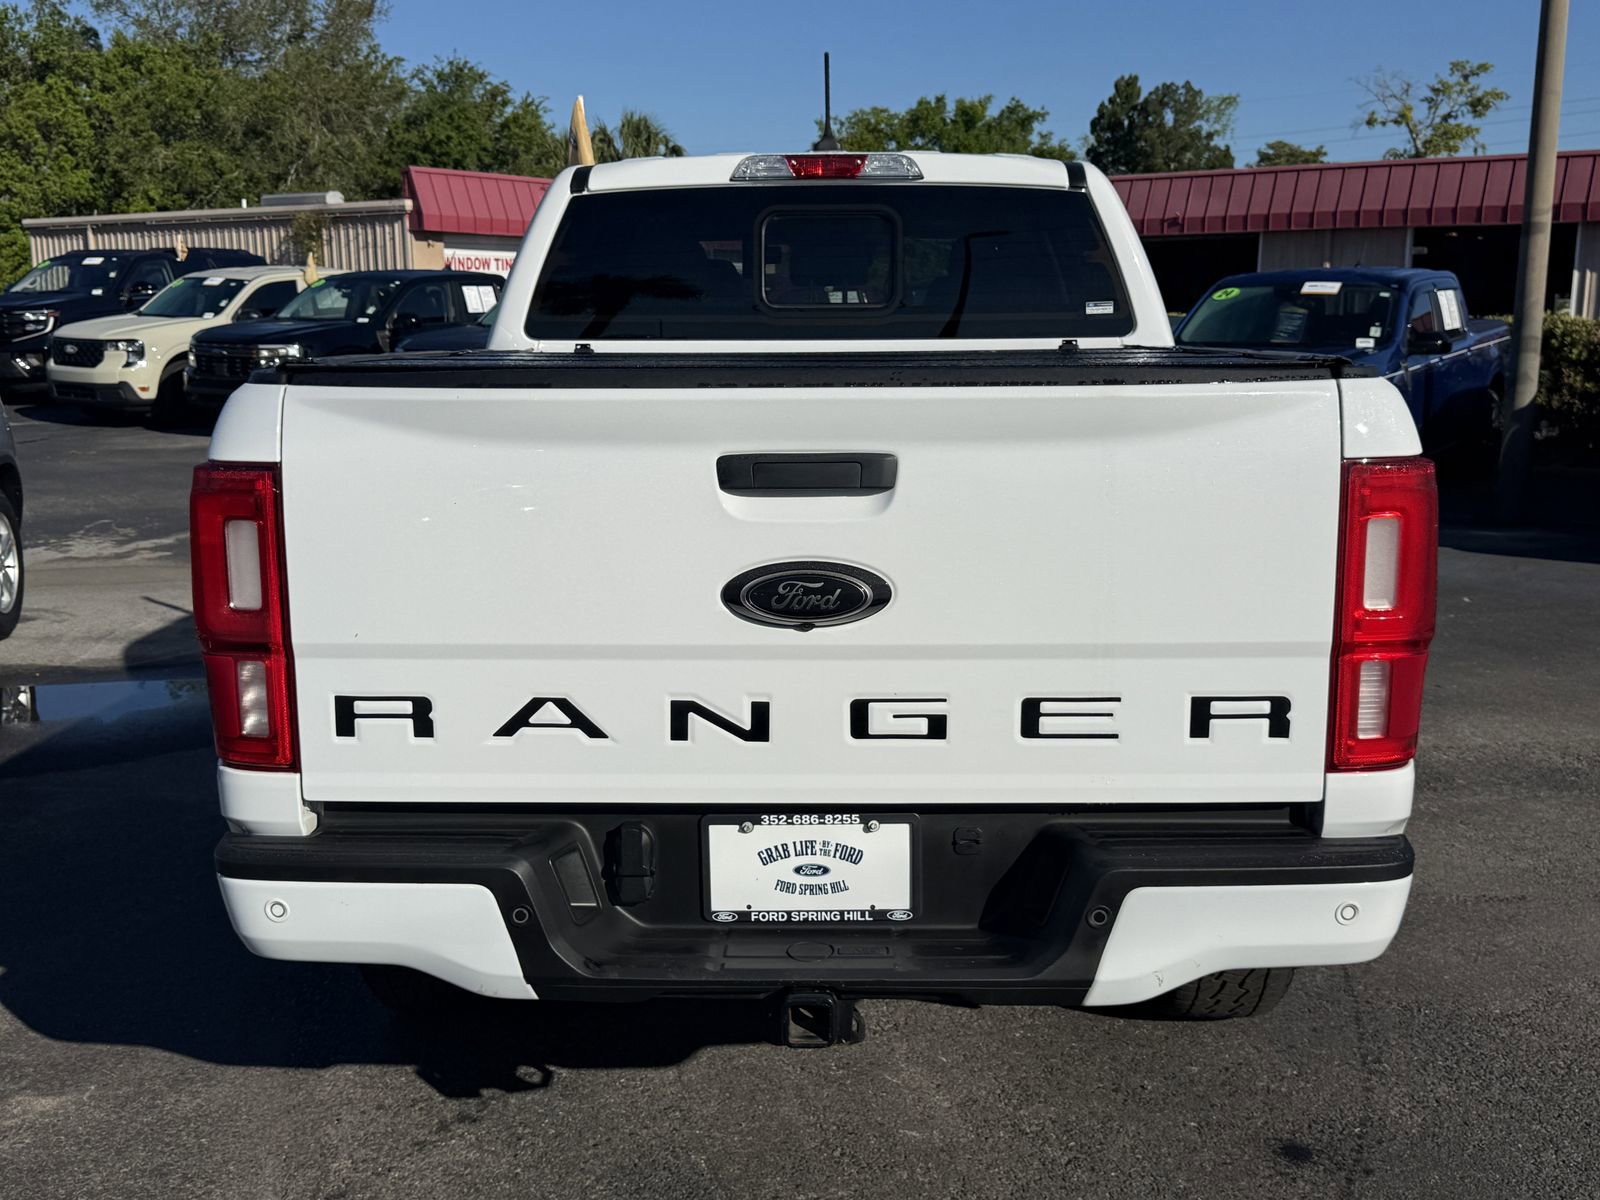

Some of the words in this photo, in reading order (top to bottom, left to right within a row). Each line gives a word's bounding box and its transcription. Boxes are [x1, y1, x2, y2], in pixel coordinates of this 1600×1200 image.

[445, 256, 491, 272] WINDOW
[771, 580, 843, 611] Ford
[334, 694, 1292, 743] RANGER
[760, 814, 861, 825] 352-686-8255
[757, 842, 791, 867] GRAB
[792, 839, 817, 857] LIFE
[819, 848, 832, 857] THE
[832, 842, 864, 866] FORD
[799, 864, 824, 875] Ford
[774, 879, 797, 895] FORD
[798, 883, 829, 896] SPRING
[829, 879, 850, 894] HILL
[751, 911, 788, 922] FORD
[790, 911, 841, 922] SPRING
[843, 910, 874, 921] HILL
